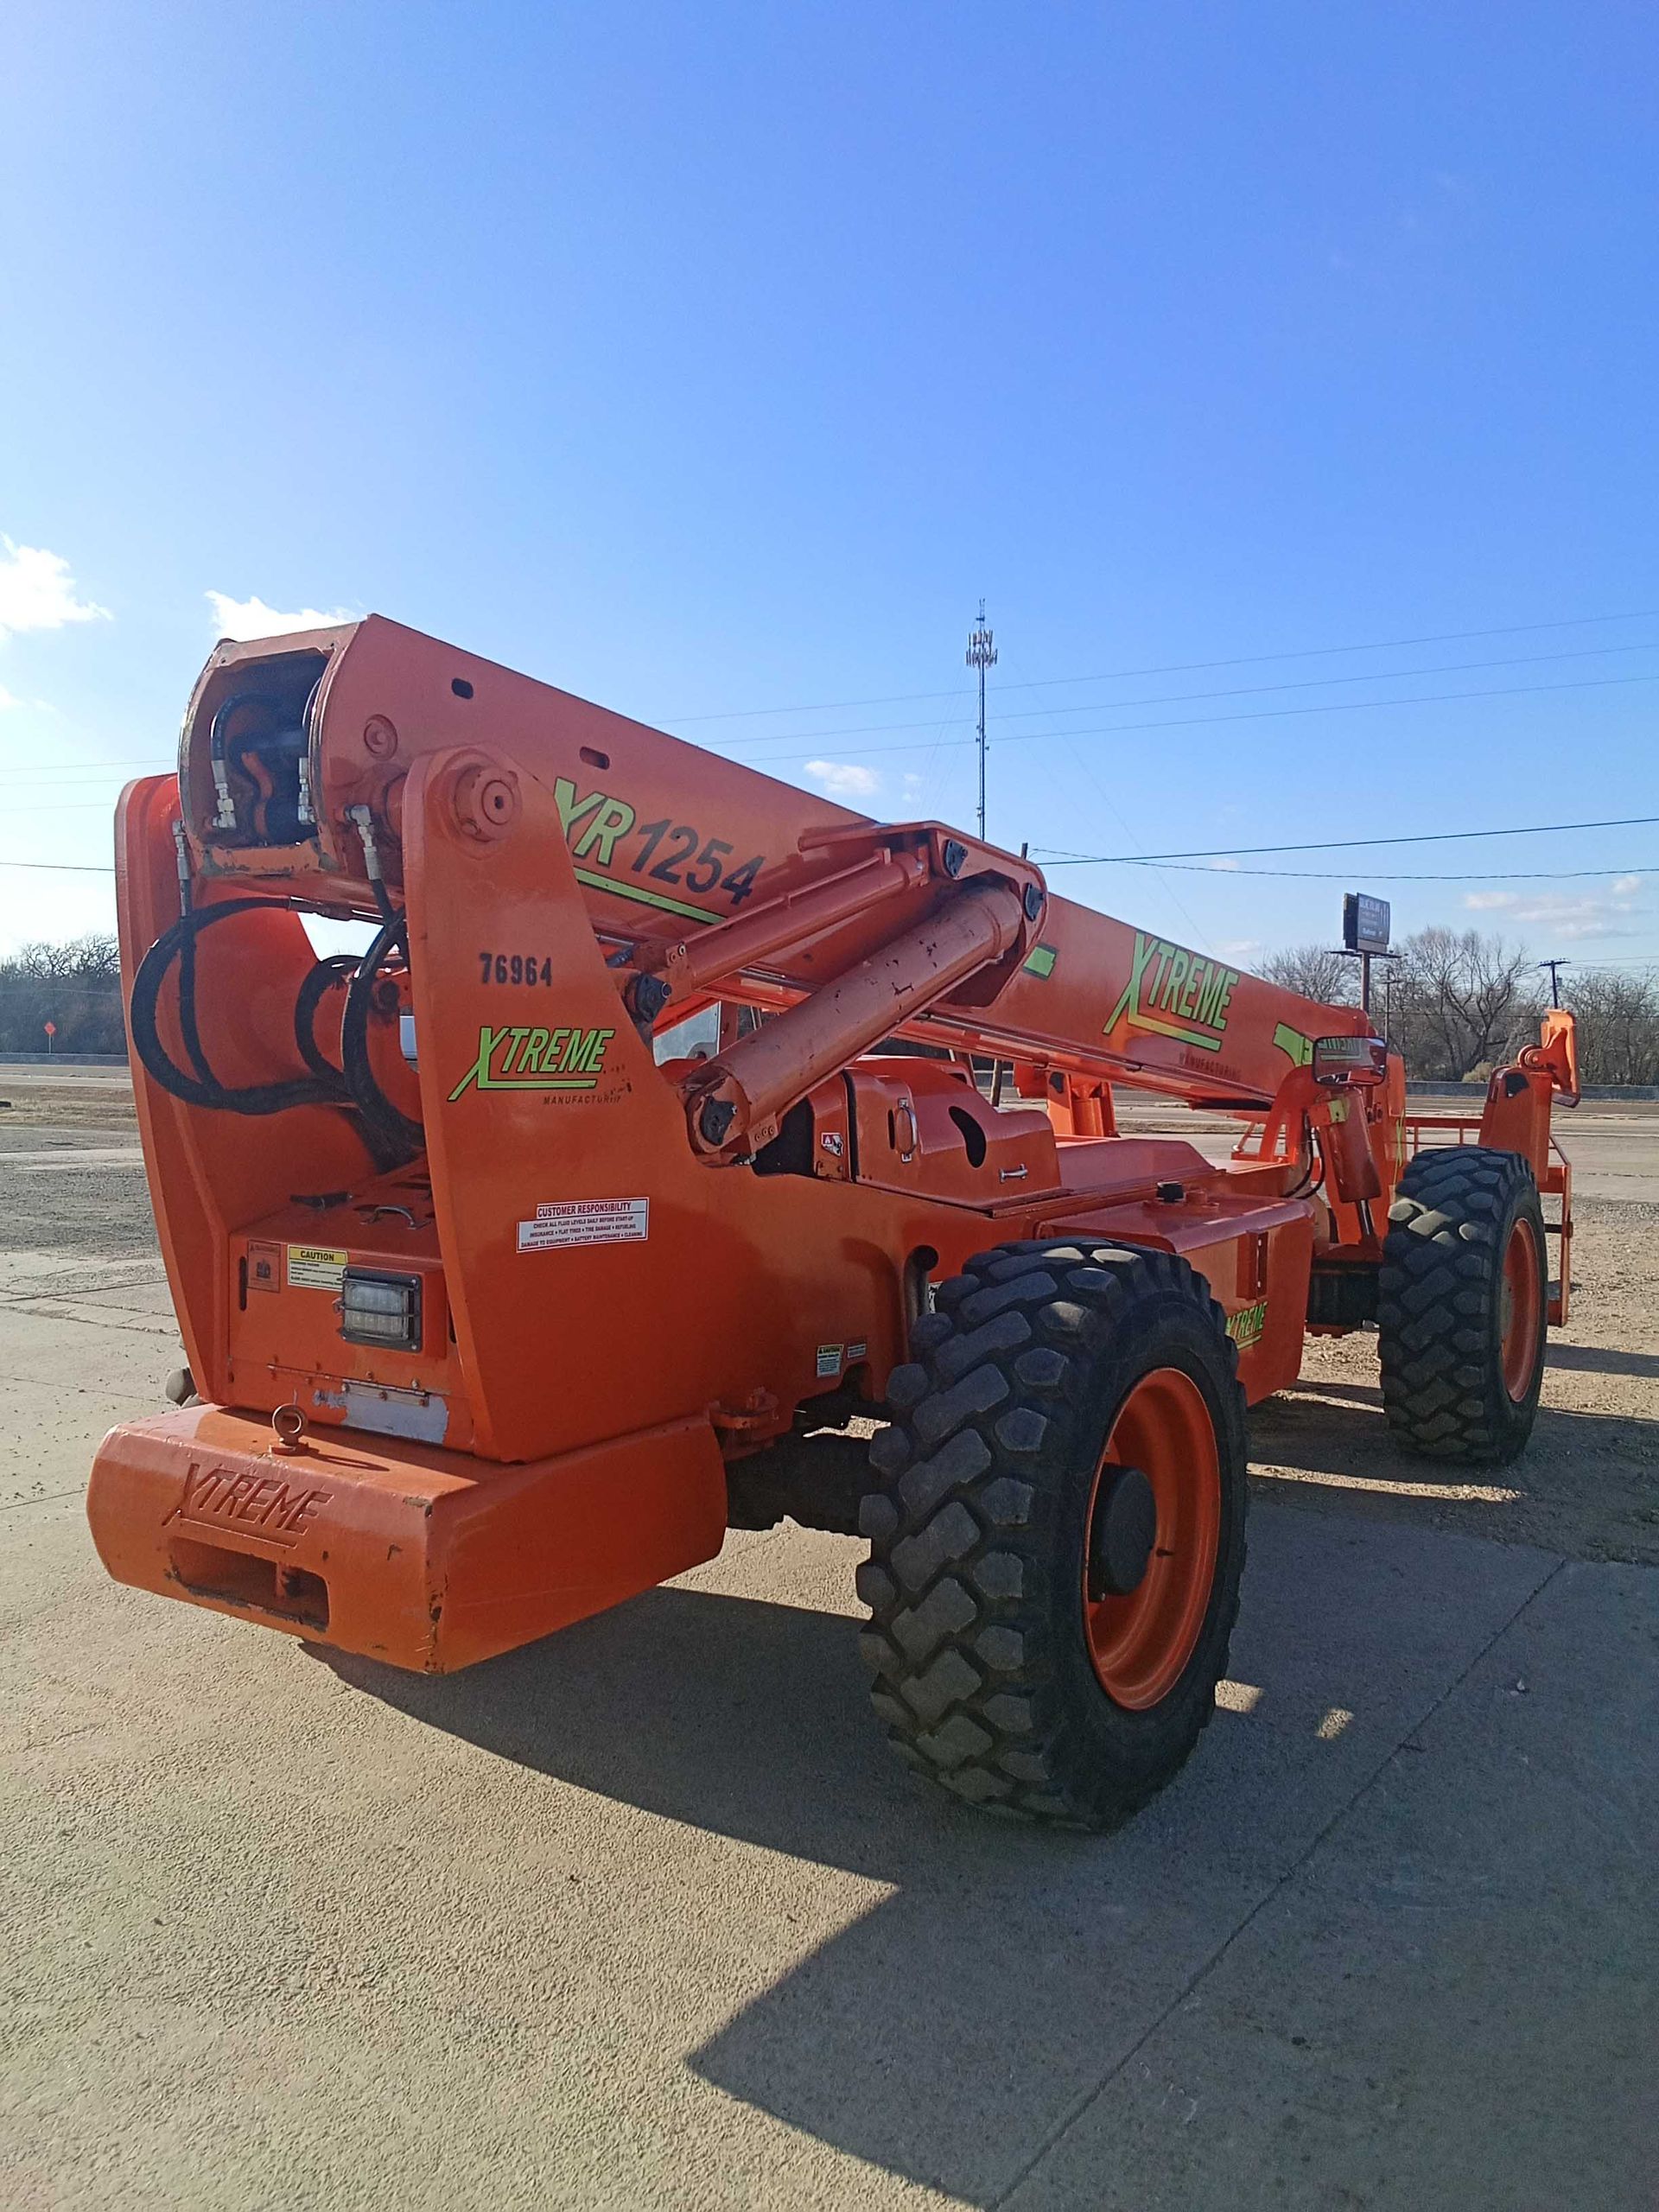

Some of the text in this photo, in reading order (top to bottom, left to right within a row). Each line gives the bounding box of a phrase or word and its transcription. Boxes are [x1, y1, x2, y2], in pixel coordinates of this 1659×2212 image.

[480, 952, 553, 987] 76964
[1103, 930, 1240, 1052] XTREME
[447, 1026, 615, 1102] XTREME
[537, 1202, 632, 1217] CUSTOMER RESPONSIBILITY
[300, 1250, 335, 1262] CAUTION
[162, 1463, 335, 1549] XTREME
